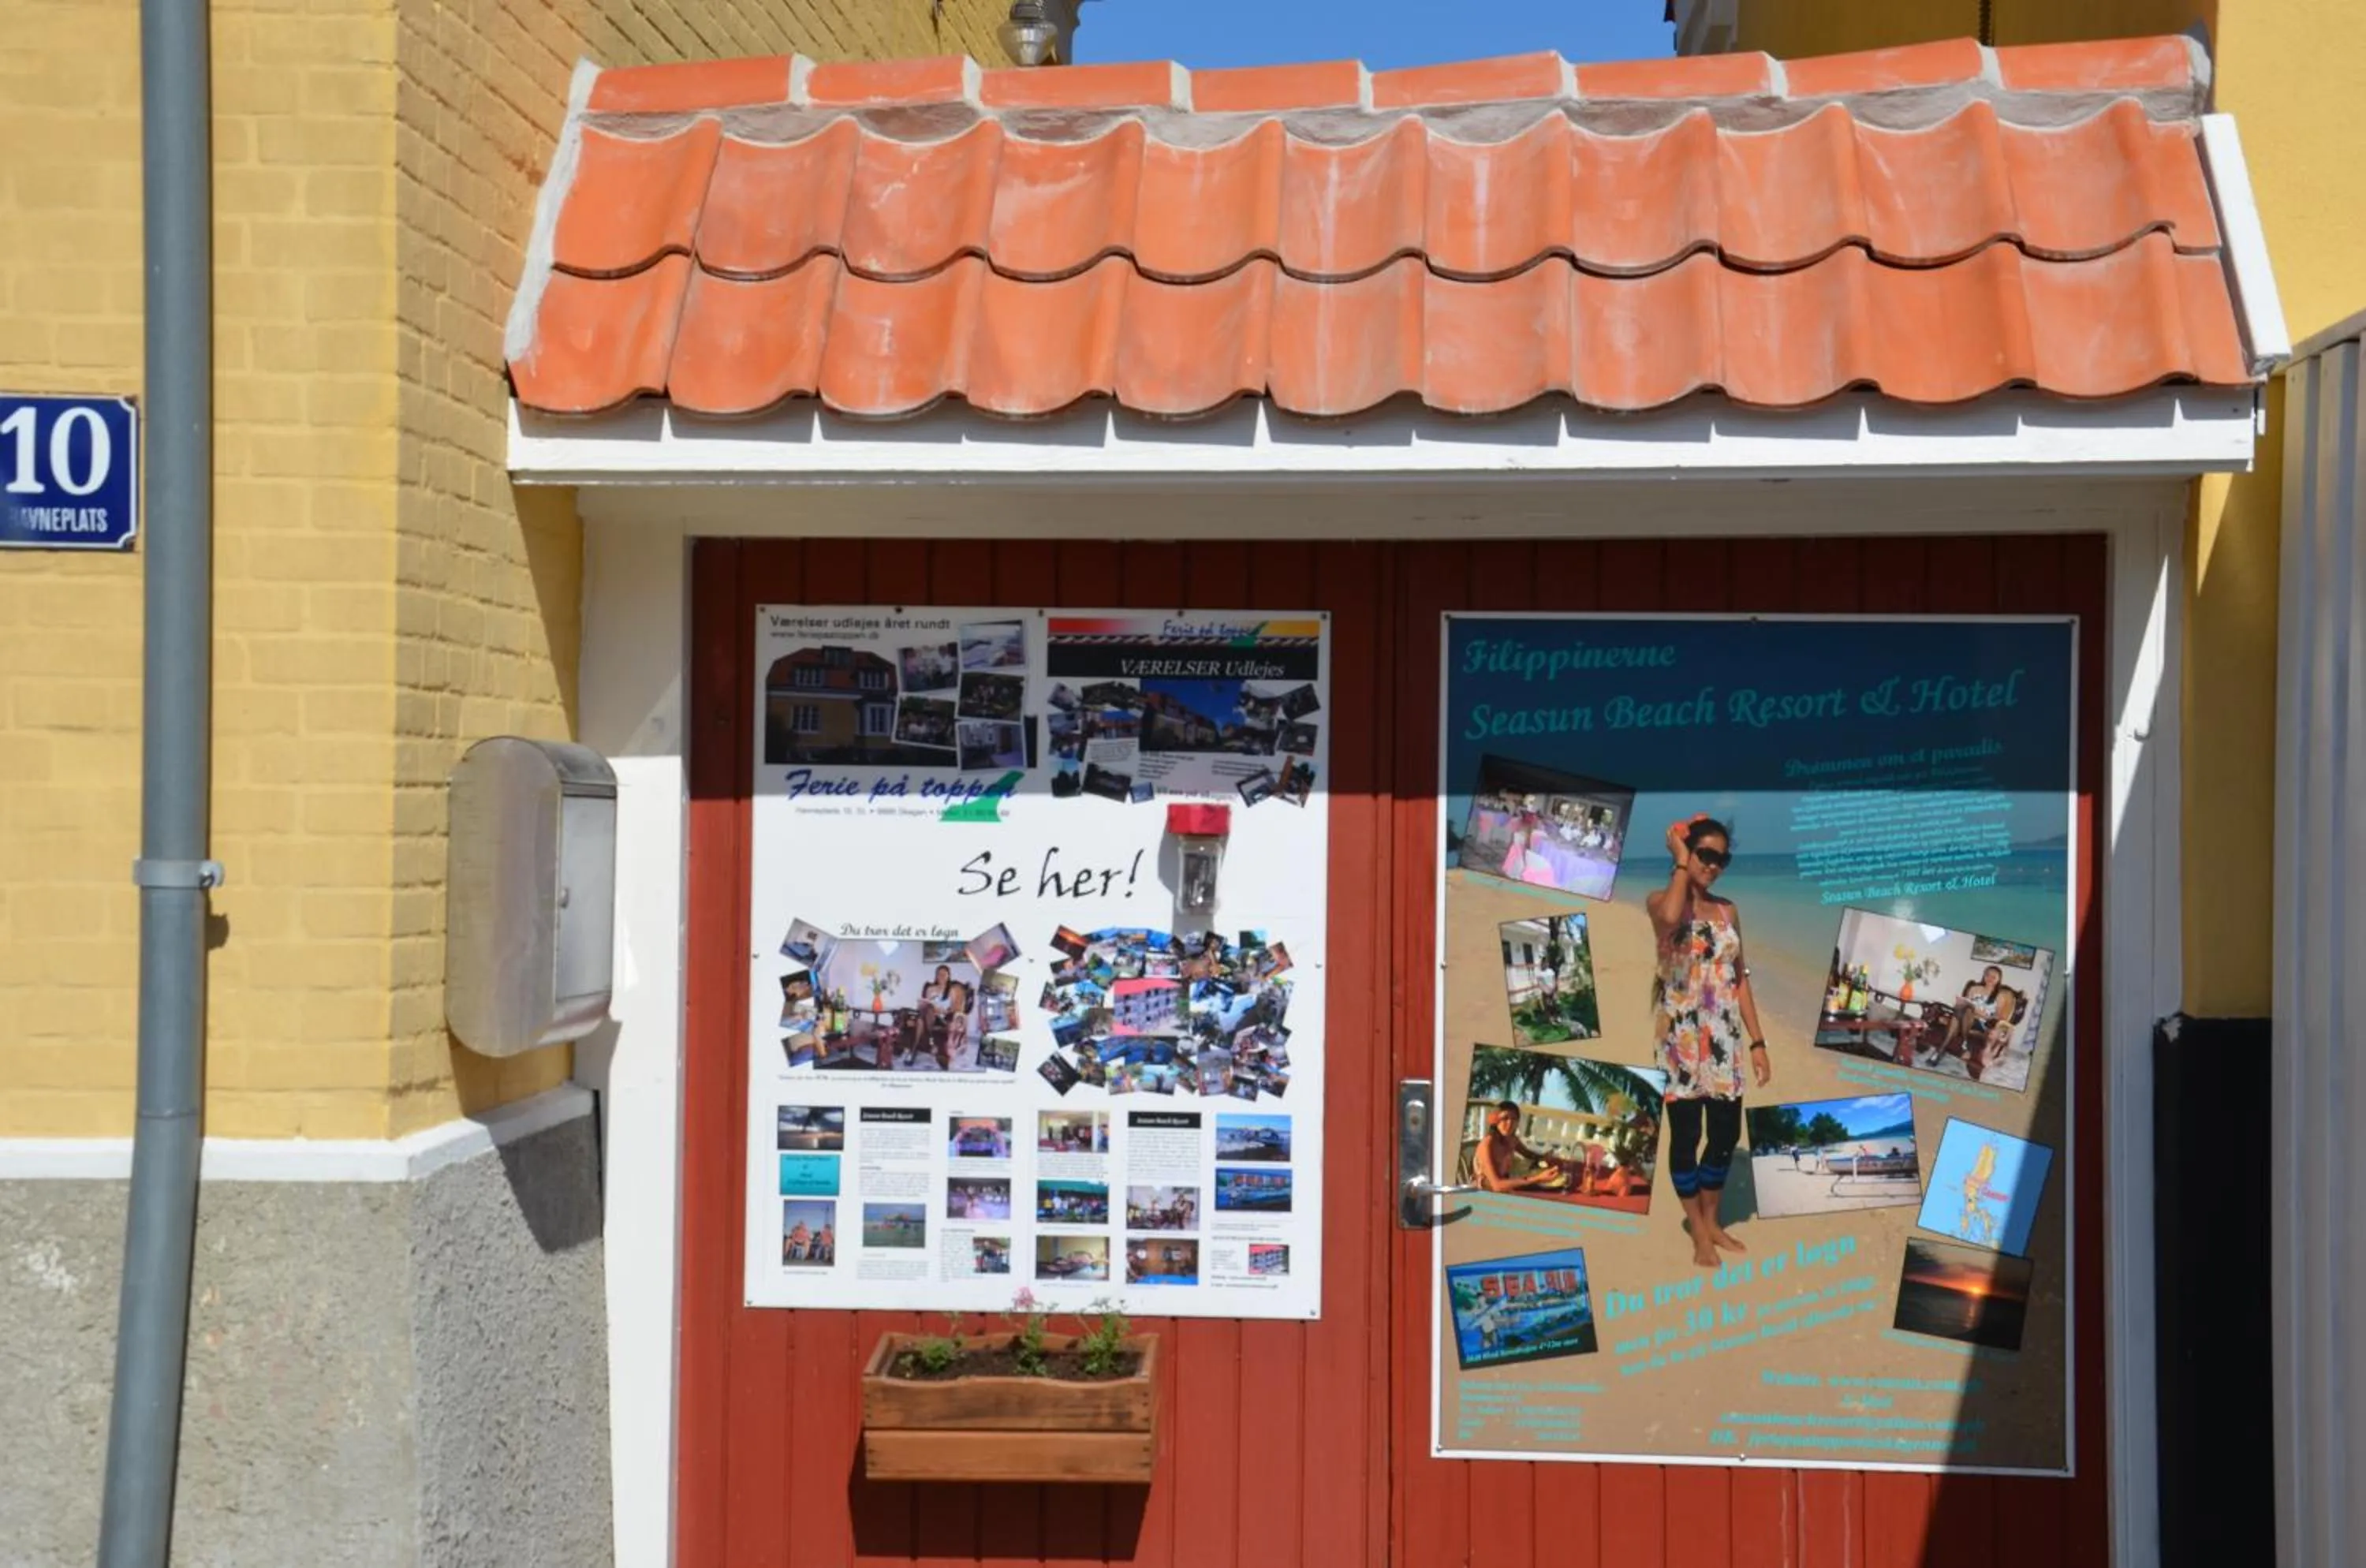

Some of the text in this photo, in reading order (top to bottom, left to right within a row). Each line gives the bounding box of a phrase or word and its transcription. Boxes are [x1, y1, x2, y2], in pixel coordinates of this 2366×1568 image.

[0, 406, 111, 496] 10
[915, 618, 951, 629] rundt
[1121, 659, 1286, 679] VÆRELSER Udlejes
[1464, 639, 1676, 681] Filippinerne
[1465, 667, 2025, 740] Seasun Beach Resort & Hotel
[785, 769, 860, 800] Ferie
[868, 774, 909, 804] på
[957, 846, 1144, 898] Se her!
[840, 924, 860, 936] Du
[892, 924, 912, 936] det
[1606, 1290, 1644, 1320] Du
[1711, 1260, 1752, 1291] det
[1760, 1253, 1789, 1279] er
